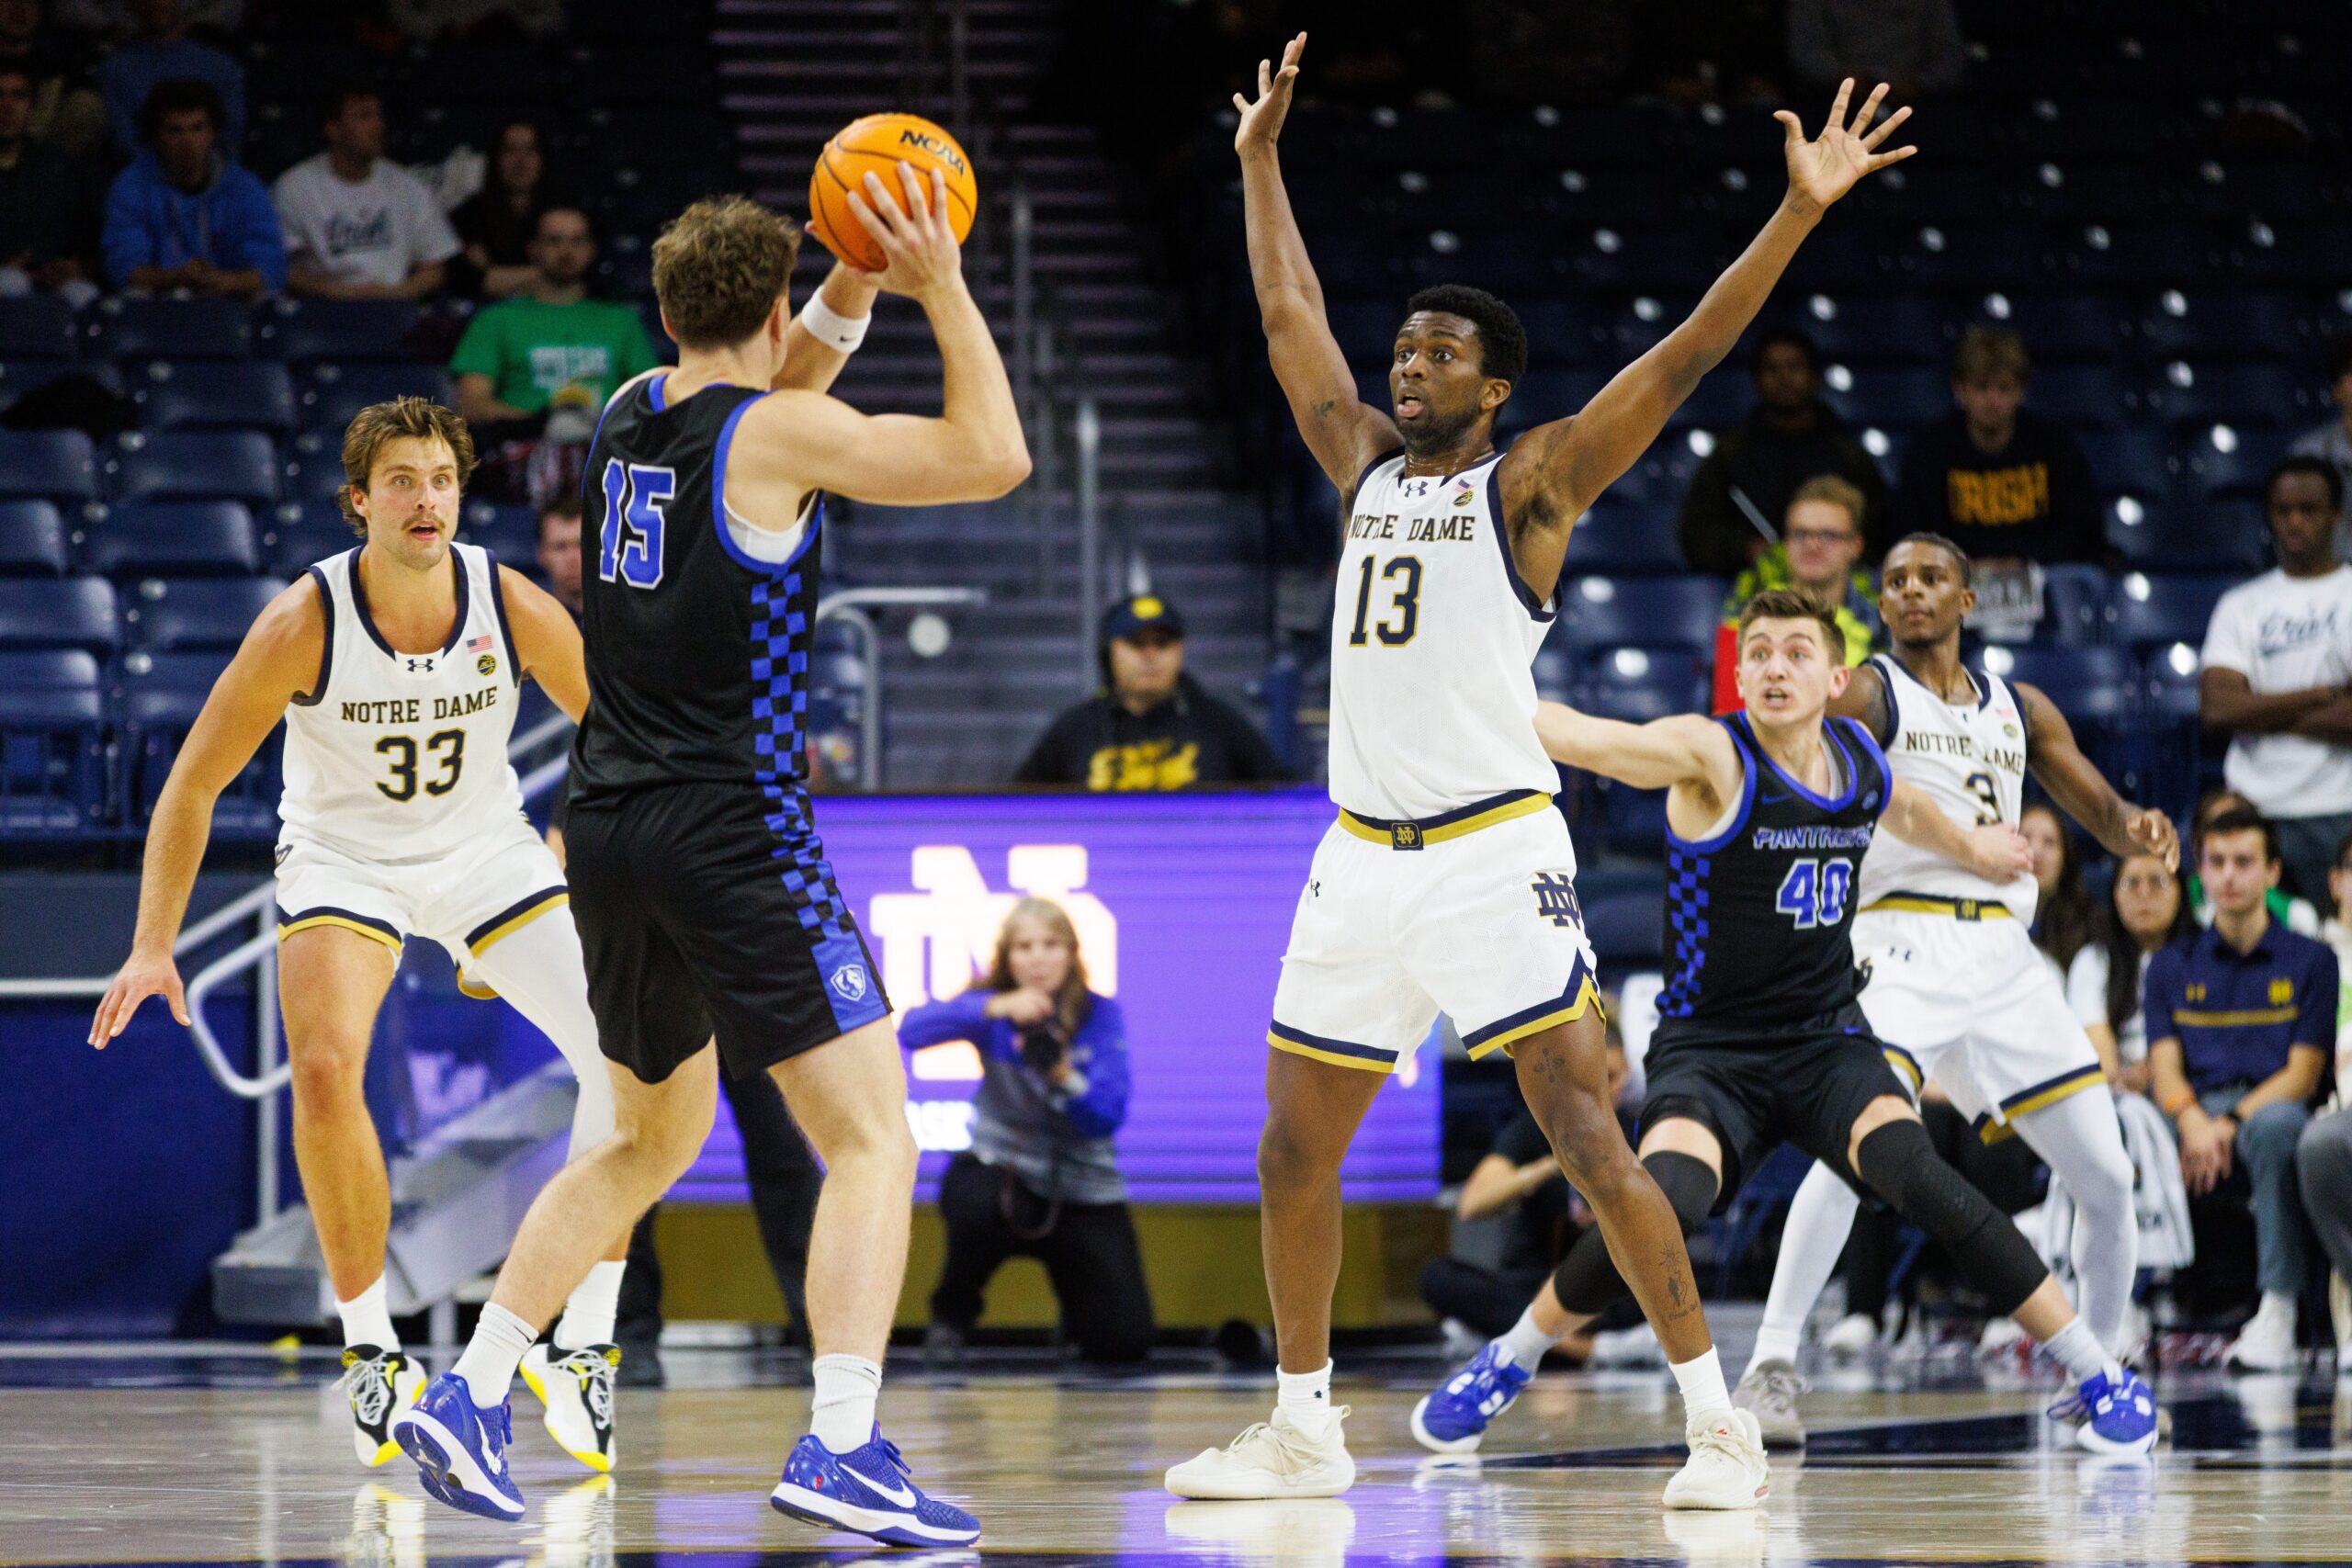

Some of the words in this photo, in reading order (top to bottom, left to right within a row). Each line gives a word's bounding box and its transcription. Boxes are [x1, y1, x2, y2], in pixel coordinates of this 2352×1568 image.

[899, 130, 964, 176] NCAA
[600, 456, 676, 590] 15
[1350, 513, 1399, 539] NOTE
[1407, 515, 1476, 542] DAME
[1349, 553, 1424, 648] 13
[341, 699, 420, 724] NOTRE
[434, 686, 497, 720] DAME
[375, 727, 468, 803] 33
[1905, 731, 1973, 757] NOTRE
[1775, 857, 1853, 930] 40
